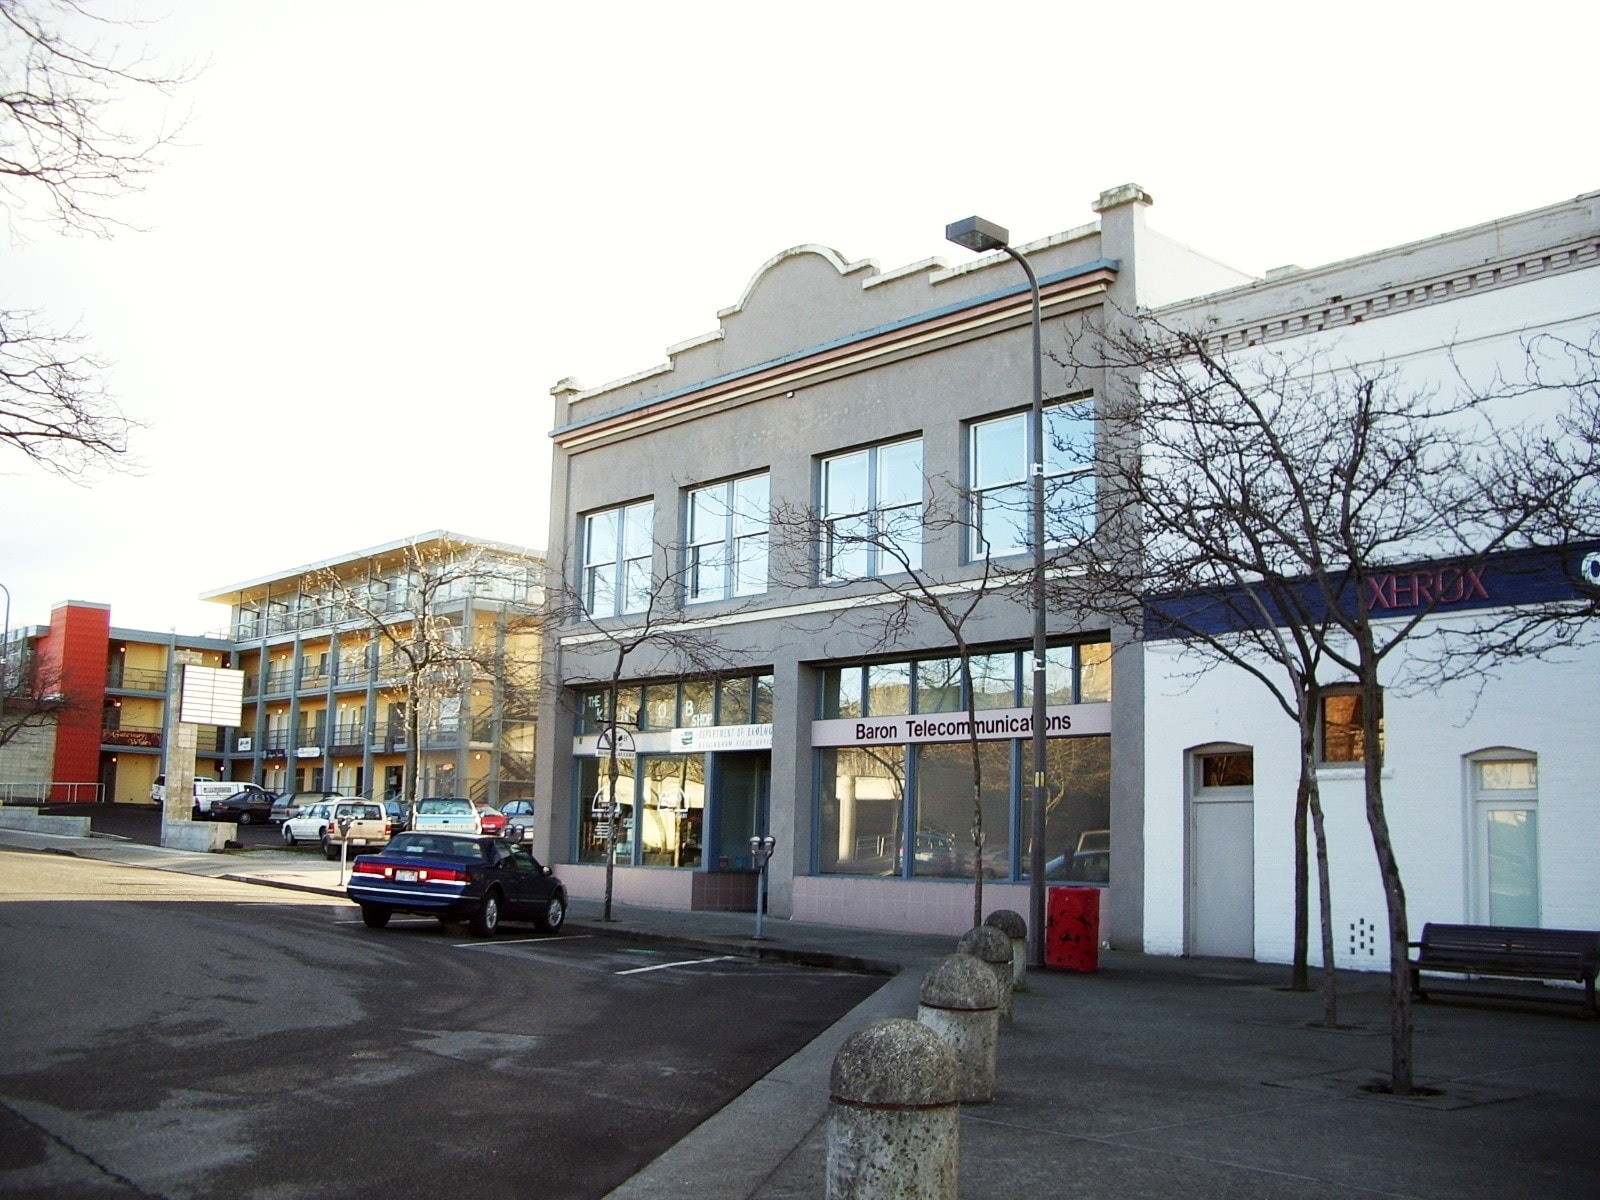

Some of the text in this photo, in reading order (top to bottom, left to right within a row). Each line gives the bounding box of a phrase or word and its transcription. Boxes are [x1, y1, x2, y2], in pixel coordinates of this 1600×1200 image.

[1368, 564, 1489, 610] XEROX
[587, 694, 602, 708] THE
[691, 712, 713, 727] SHOP
[905, 714, 1071, 738] Telecommunicatons
[747, 727, 773, 738] ECOLOG
[855, 723, 898, 740] Baron
